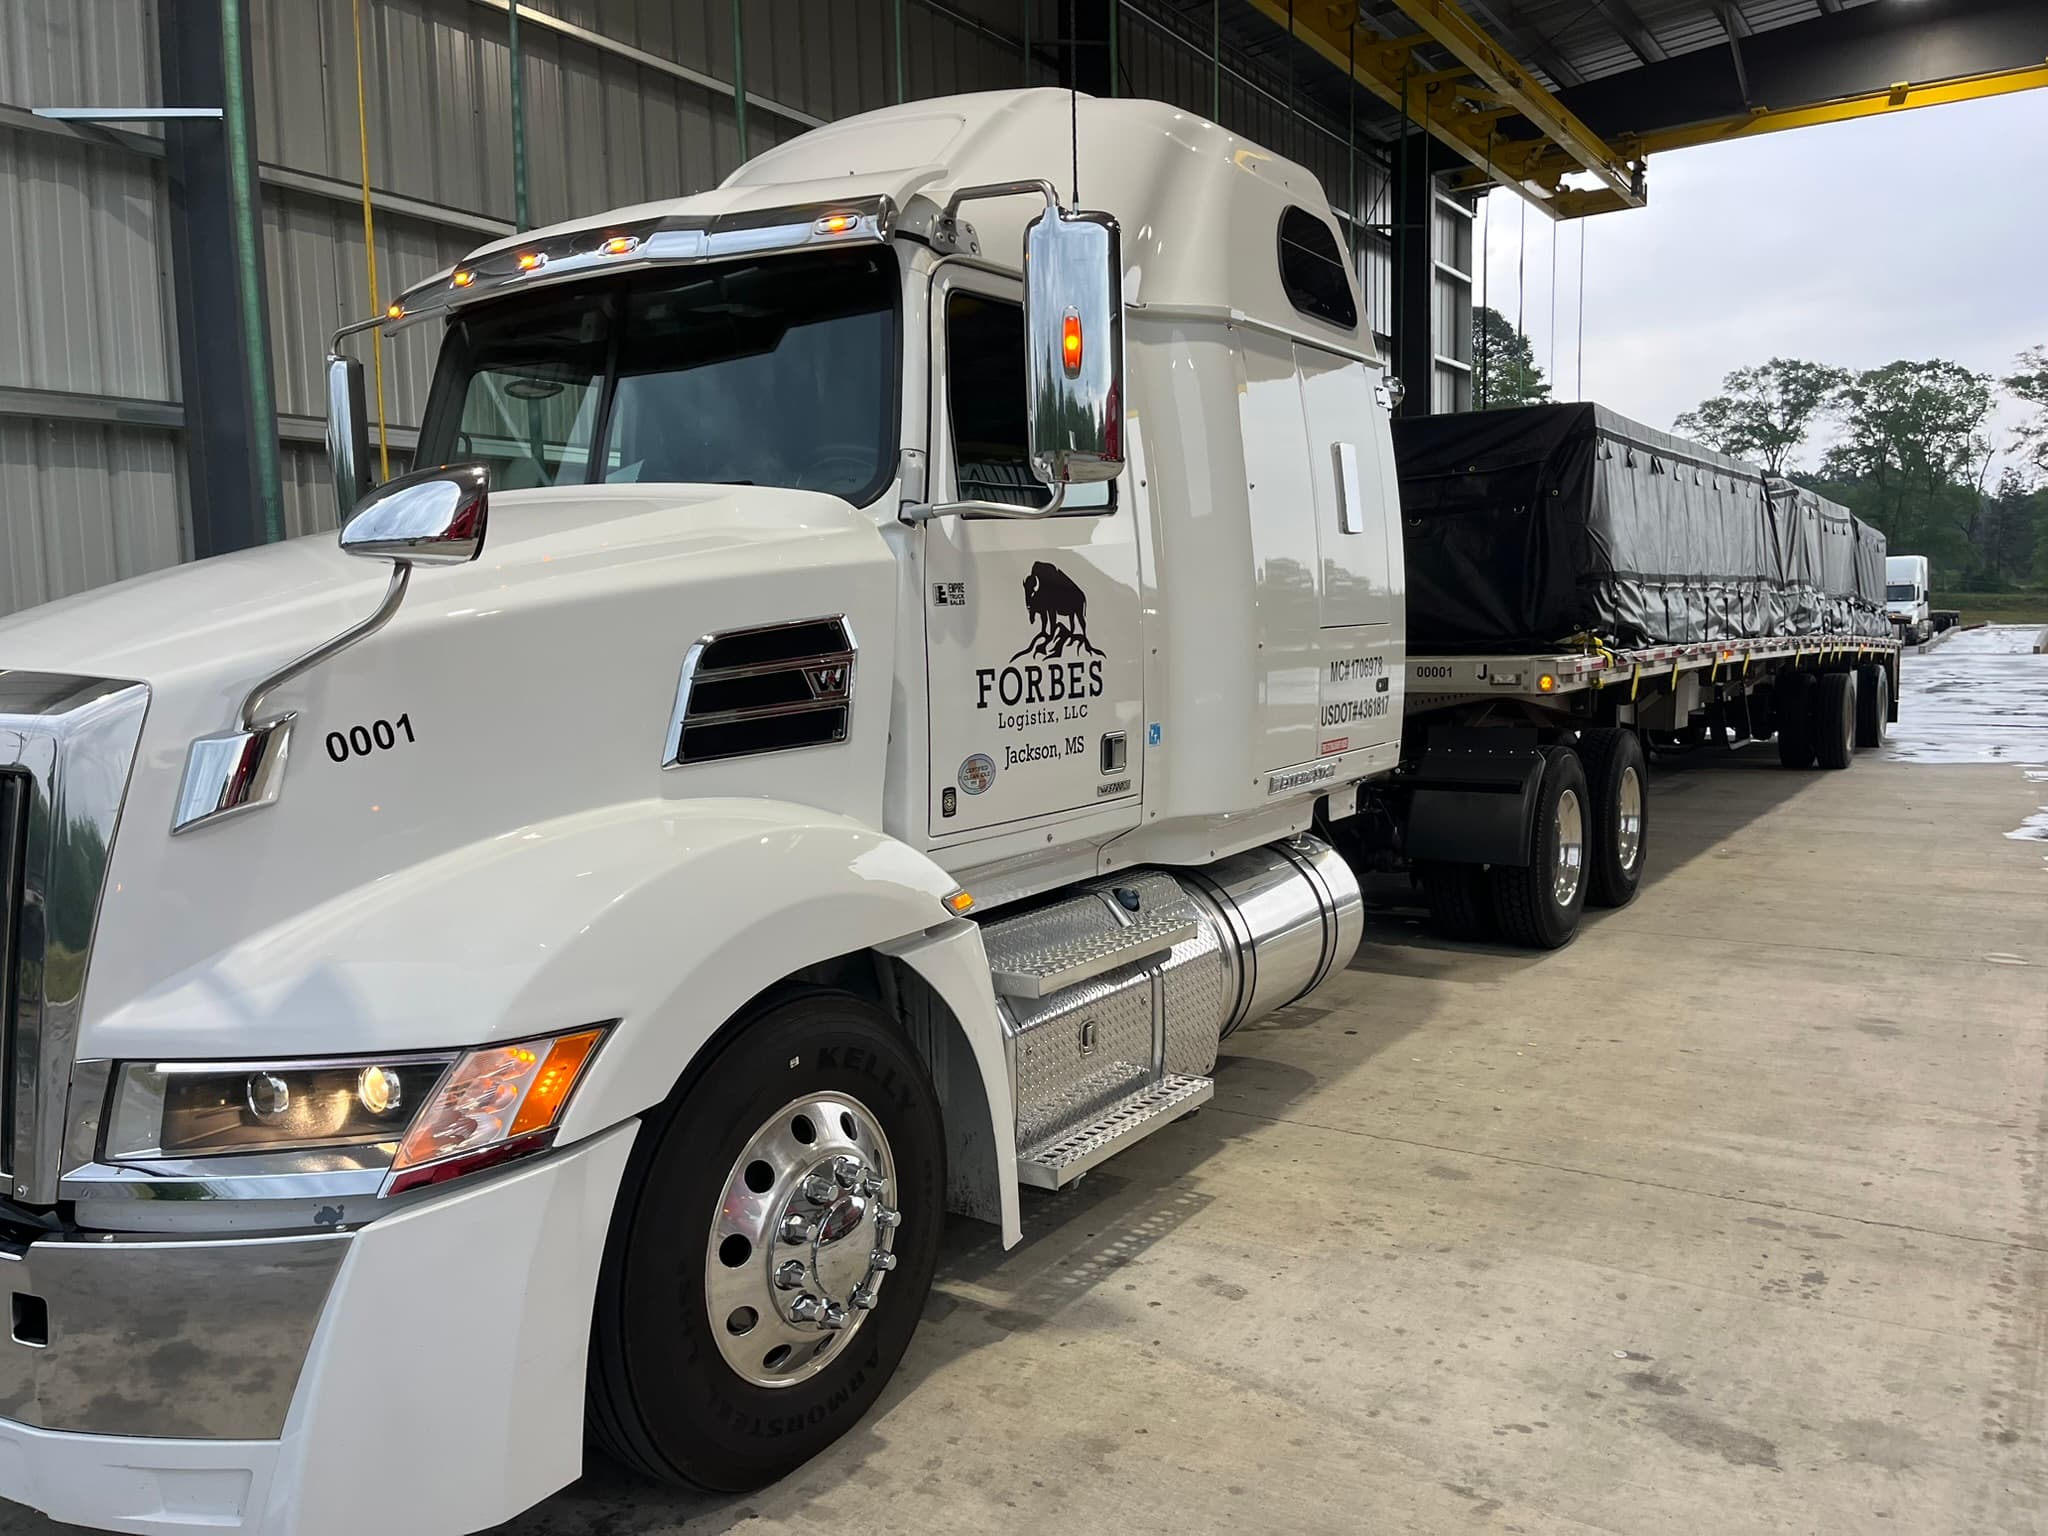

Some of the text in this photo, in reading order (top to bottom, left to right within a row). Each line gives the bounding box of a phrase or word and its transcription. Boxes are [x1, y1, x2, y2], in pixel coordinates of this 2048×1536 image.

[976, 660, 1103, 709] FORBES
[1330, 656, 1383, 682] MC#1706978
[1416, 664, 1488, 680] 00001 J
[998, 704, 1088, 731] Logistix, LLC
[1321, 695, 1389, 727] USDOT#4361817
[326, 713, 415, 763] 0001
[1005, 735, 1085, 770] Jackson, MS
[816, 1046, 917, 1109] KELLY
